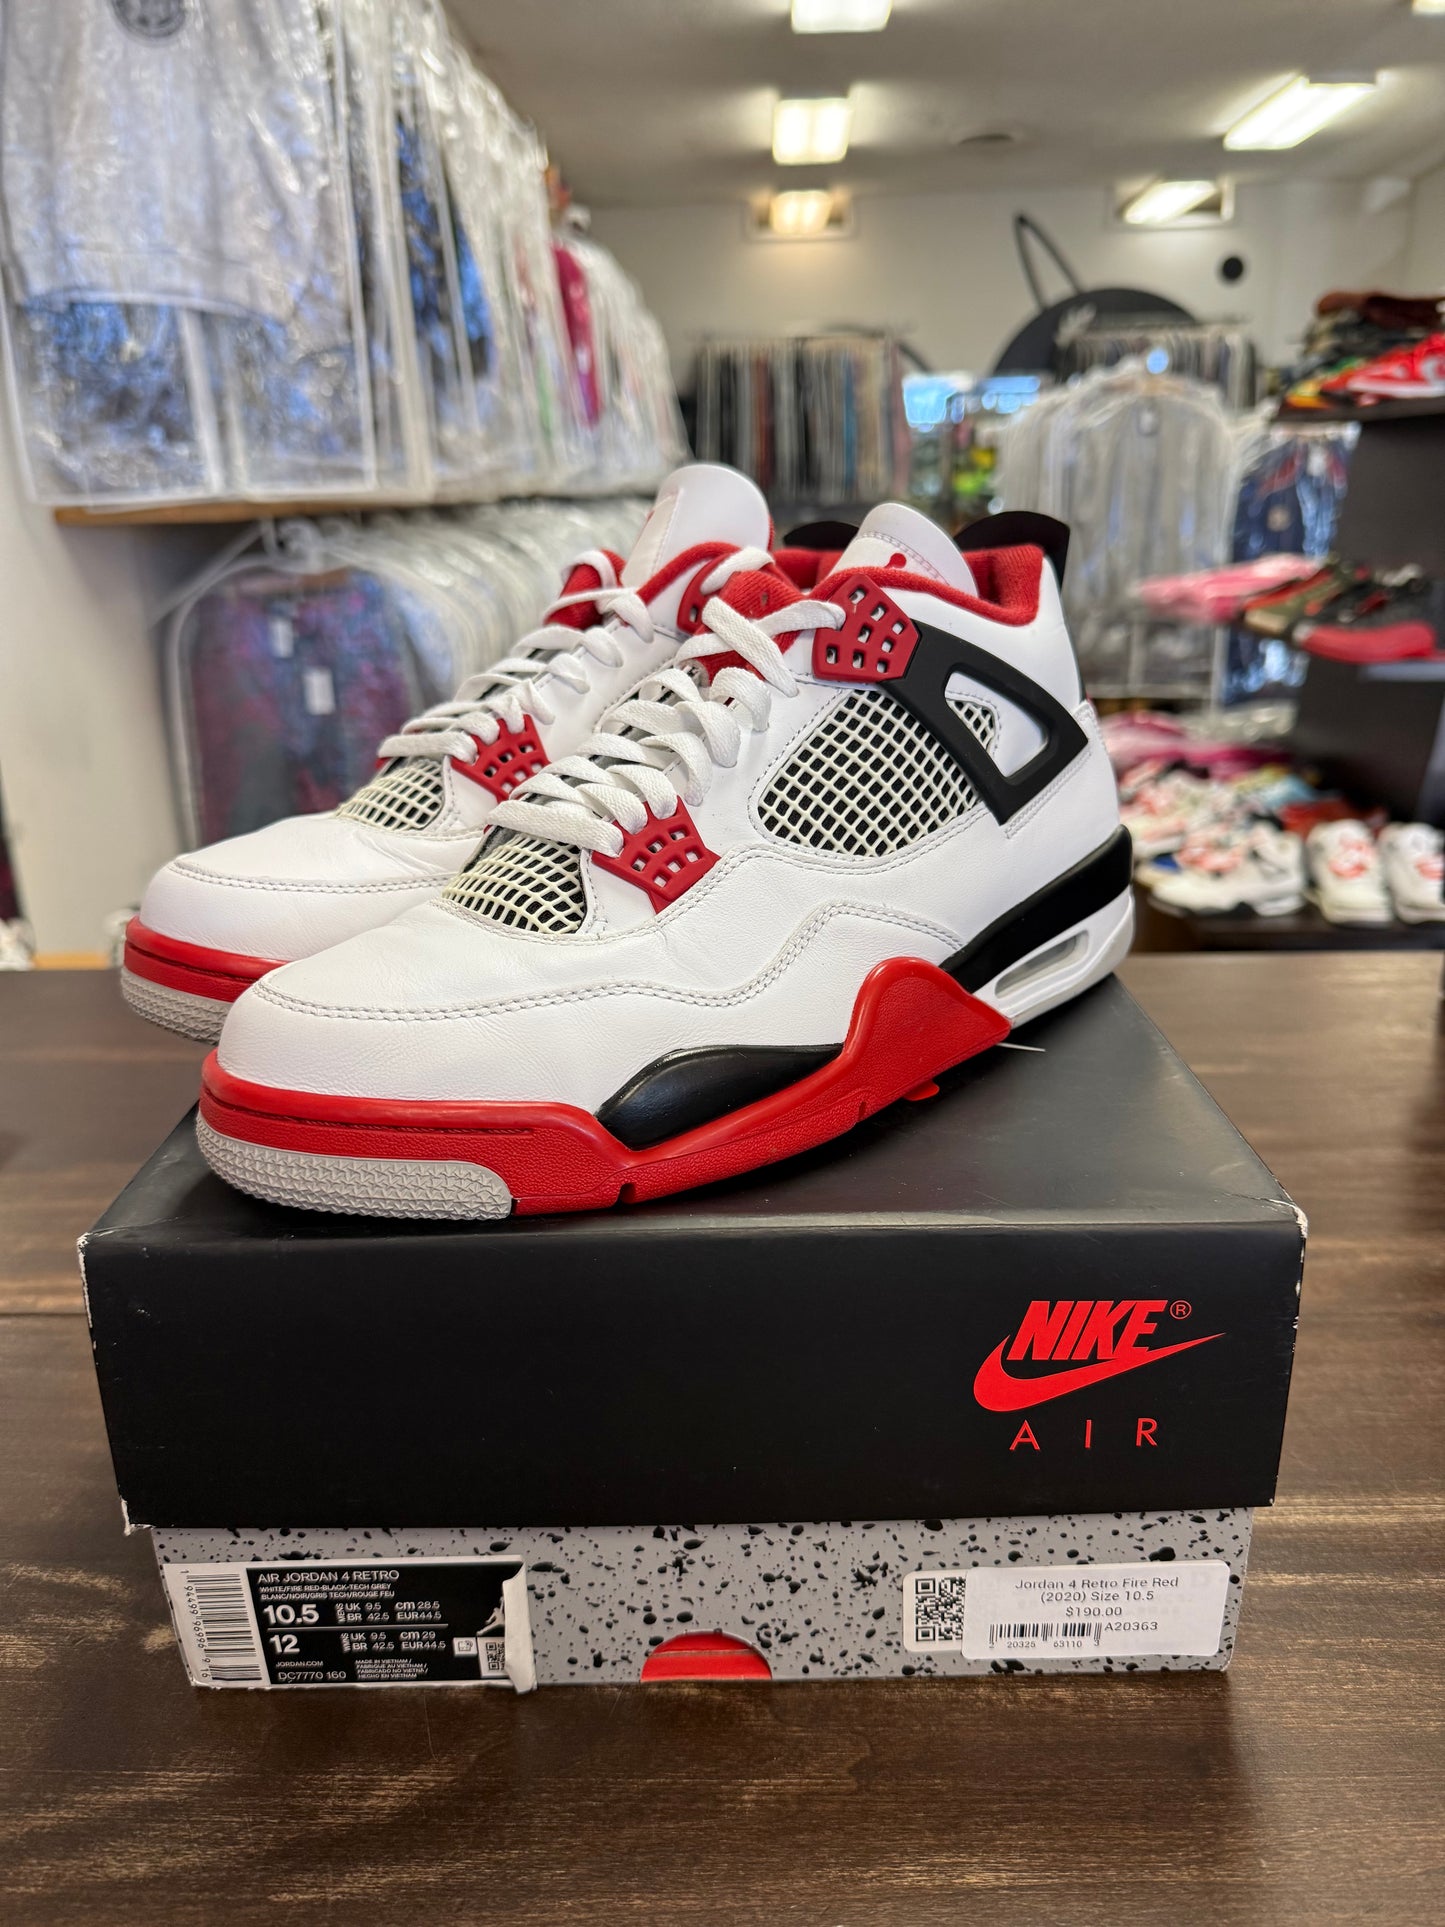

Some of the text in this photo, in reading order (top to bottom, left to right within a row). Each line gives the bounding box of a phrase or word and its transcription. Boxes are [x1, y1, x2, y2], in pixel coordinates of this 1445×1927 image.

[1006, 1300, 1168, 1360] NIKE
[1009, 1417, 1158, 1451] AIR
[258, 1569, 400, 1583] AIR JORDAN 4 RETRO
[303, 1583, 370, 1592] RED-BLACK-TECH
[1015, 1577, 1179, 1589] Jordan 4 Retro Fire Red
[261, 1590, 395, 1600] BLANC/NOIR/GRIS TECH/ROUGE FEU
[1040, 1590, 1154, 1604] (2020) Size 10.5
[345, 1601, 440, 1611] UK 9.5 cm 28.5
[263, 1603, 320, 1625] 10.5
[346, 1613, 362, 1621] BR
[367, 1612, 390, 1621] 42.5
[1065, 1606, 1122, 1617] $190.00
[184, 1585, 199, 1614] 94499
[193, 1620, 208, 1649] 96996
[1104, 1621, 1158, 1631] A20363
[350, 1631, 436, 1641] UK 9.5 cm 29
[269, 1634, 300, 1655] 12
[352, 1642, 368, 1651] BR
[372, 1641, 394, 1650] 42.5
[1006, 1640, 1036, 1648] 20325
[1053, 1640, 1083, 1648] 63110
[276, 1660, 324, 1668] JORDAN.COM
[278, 1670, 346, 1680] DC7770 160
